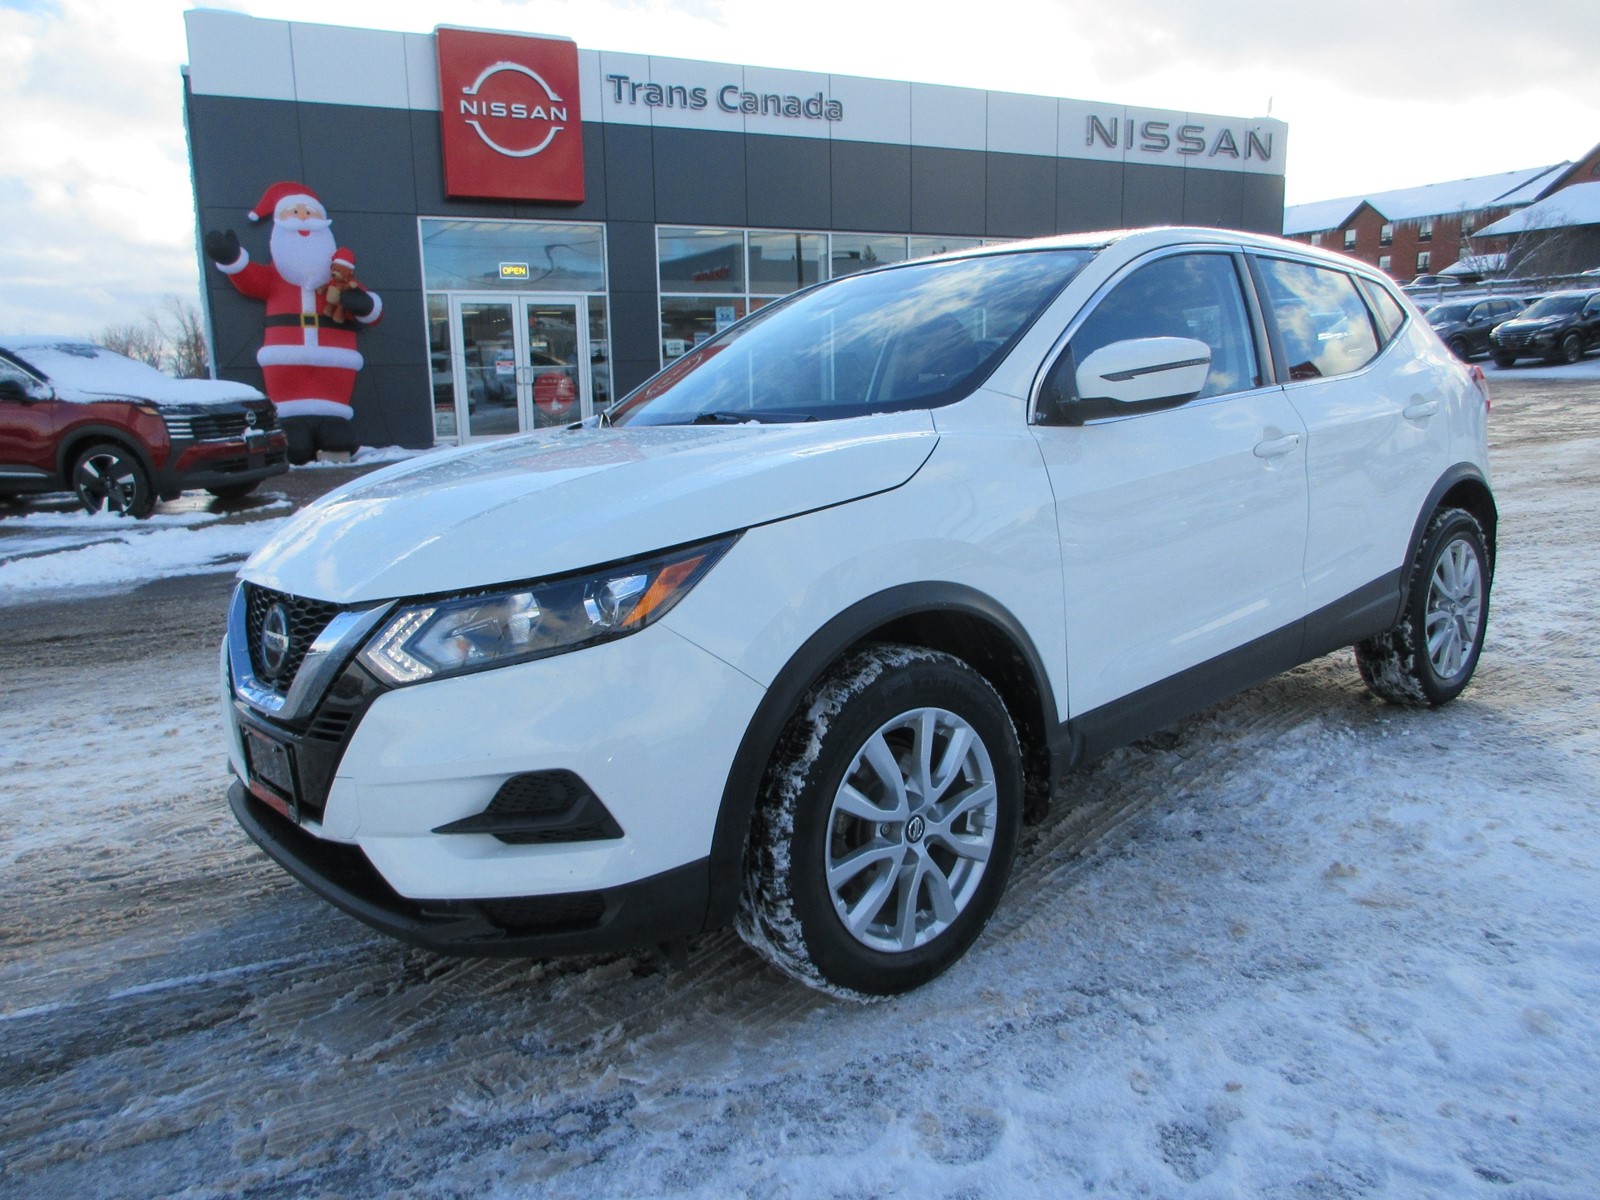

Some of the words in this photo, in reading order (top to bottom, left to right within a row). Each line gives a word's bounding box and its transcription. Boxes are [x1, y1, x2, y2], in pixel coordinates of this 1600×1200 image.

[460, 100, 567, 121] NISSAN
[607, 74, 708, 109] Trans
[717, 84, 844, 121] Canada
[1086, 115, 1273, 161] NISSAN
[502, 266, 526, 275] OPEN
